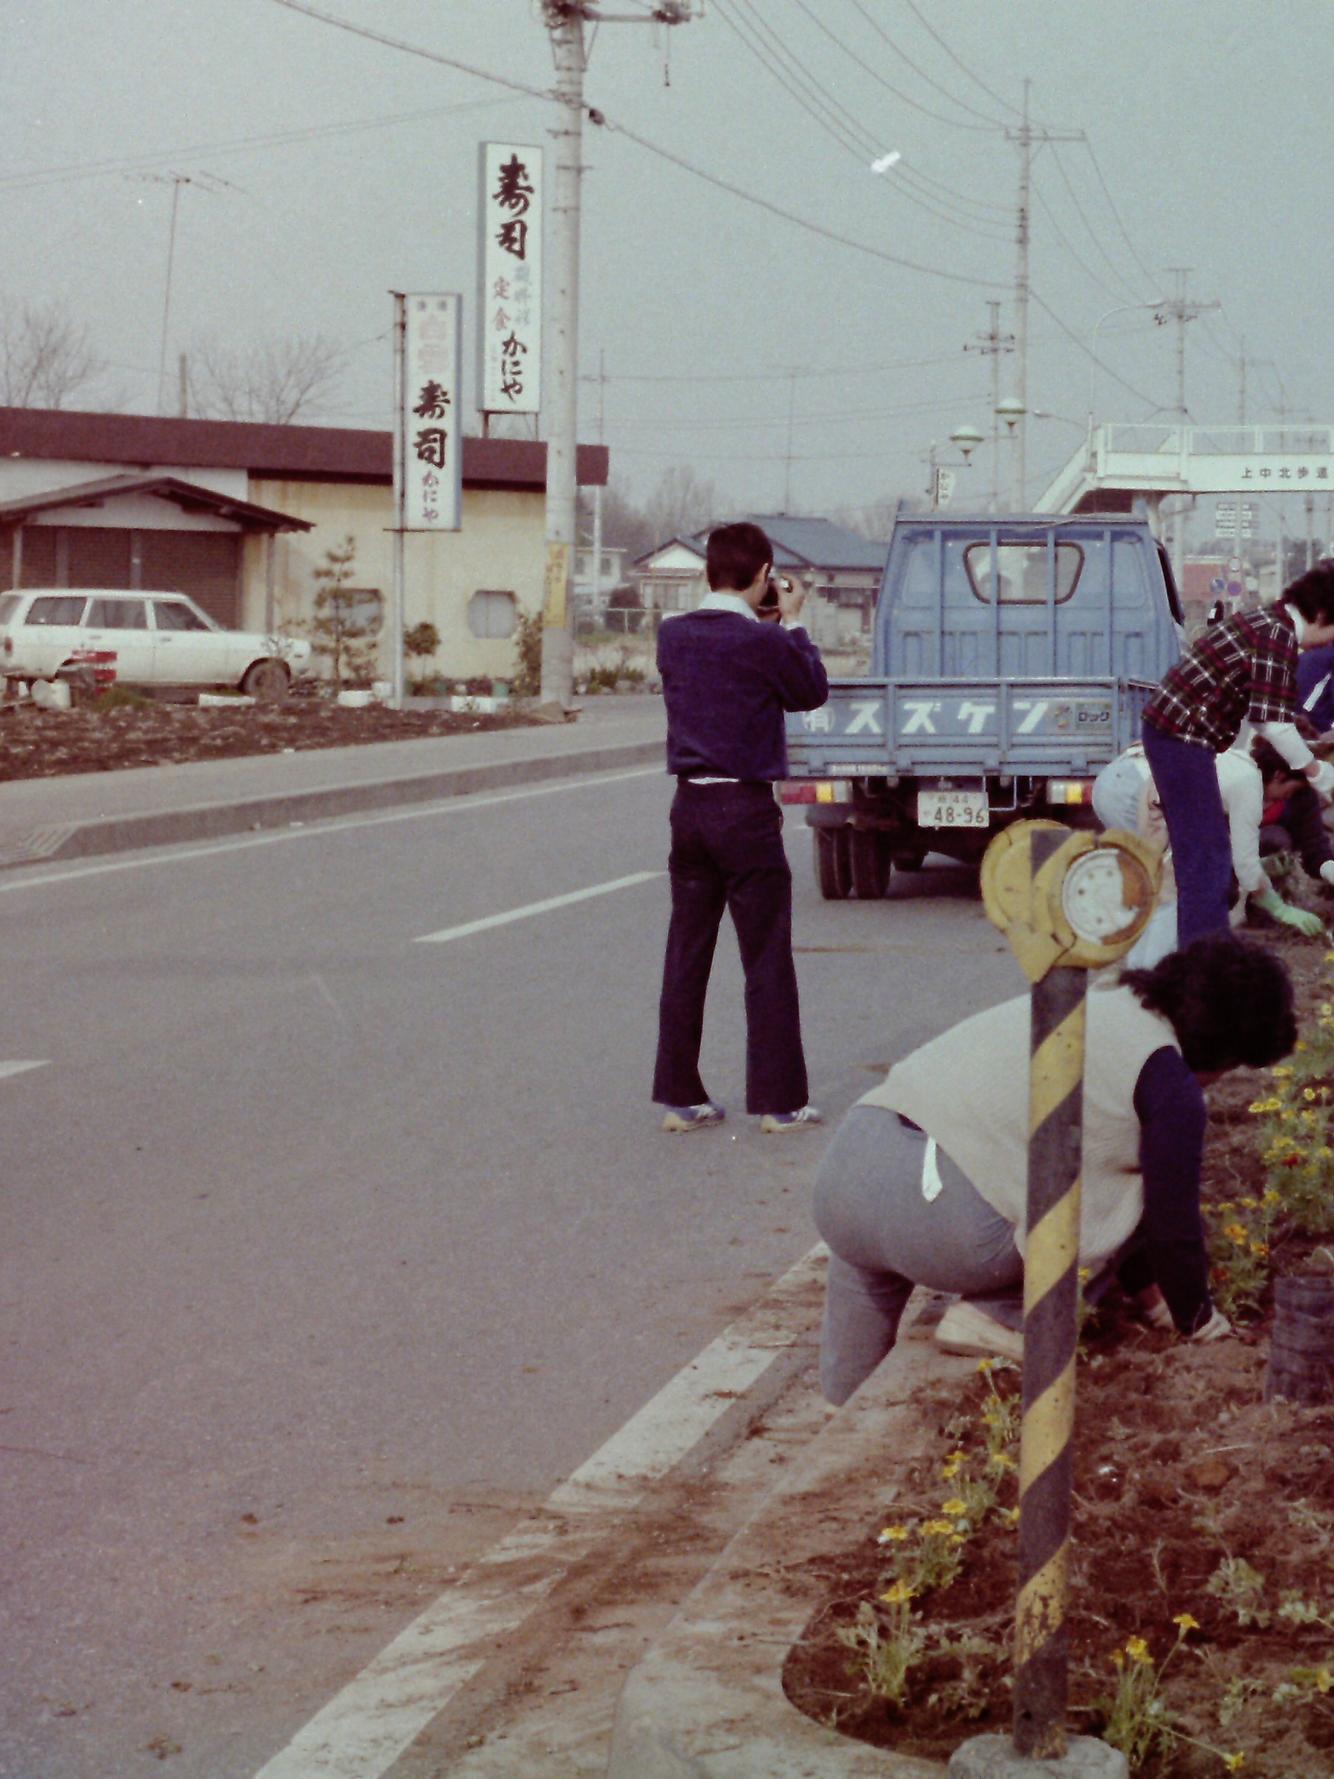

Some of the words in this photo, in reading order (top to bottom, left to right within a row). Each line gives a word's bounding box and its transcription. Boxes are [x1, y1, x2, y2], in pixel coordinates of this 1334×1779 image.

[493, 153, 535, 260] 寿司
[493, 275, 511, 332] 定食
[501, 331, 528, 404] かにや
[412, 379, 452, 469] 寿司
[421, 470, 440, 525] かにや
